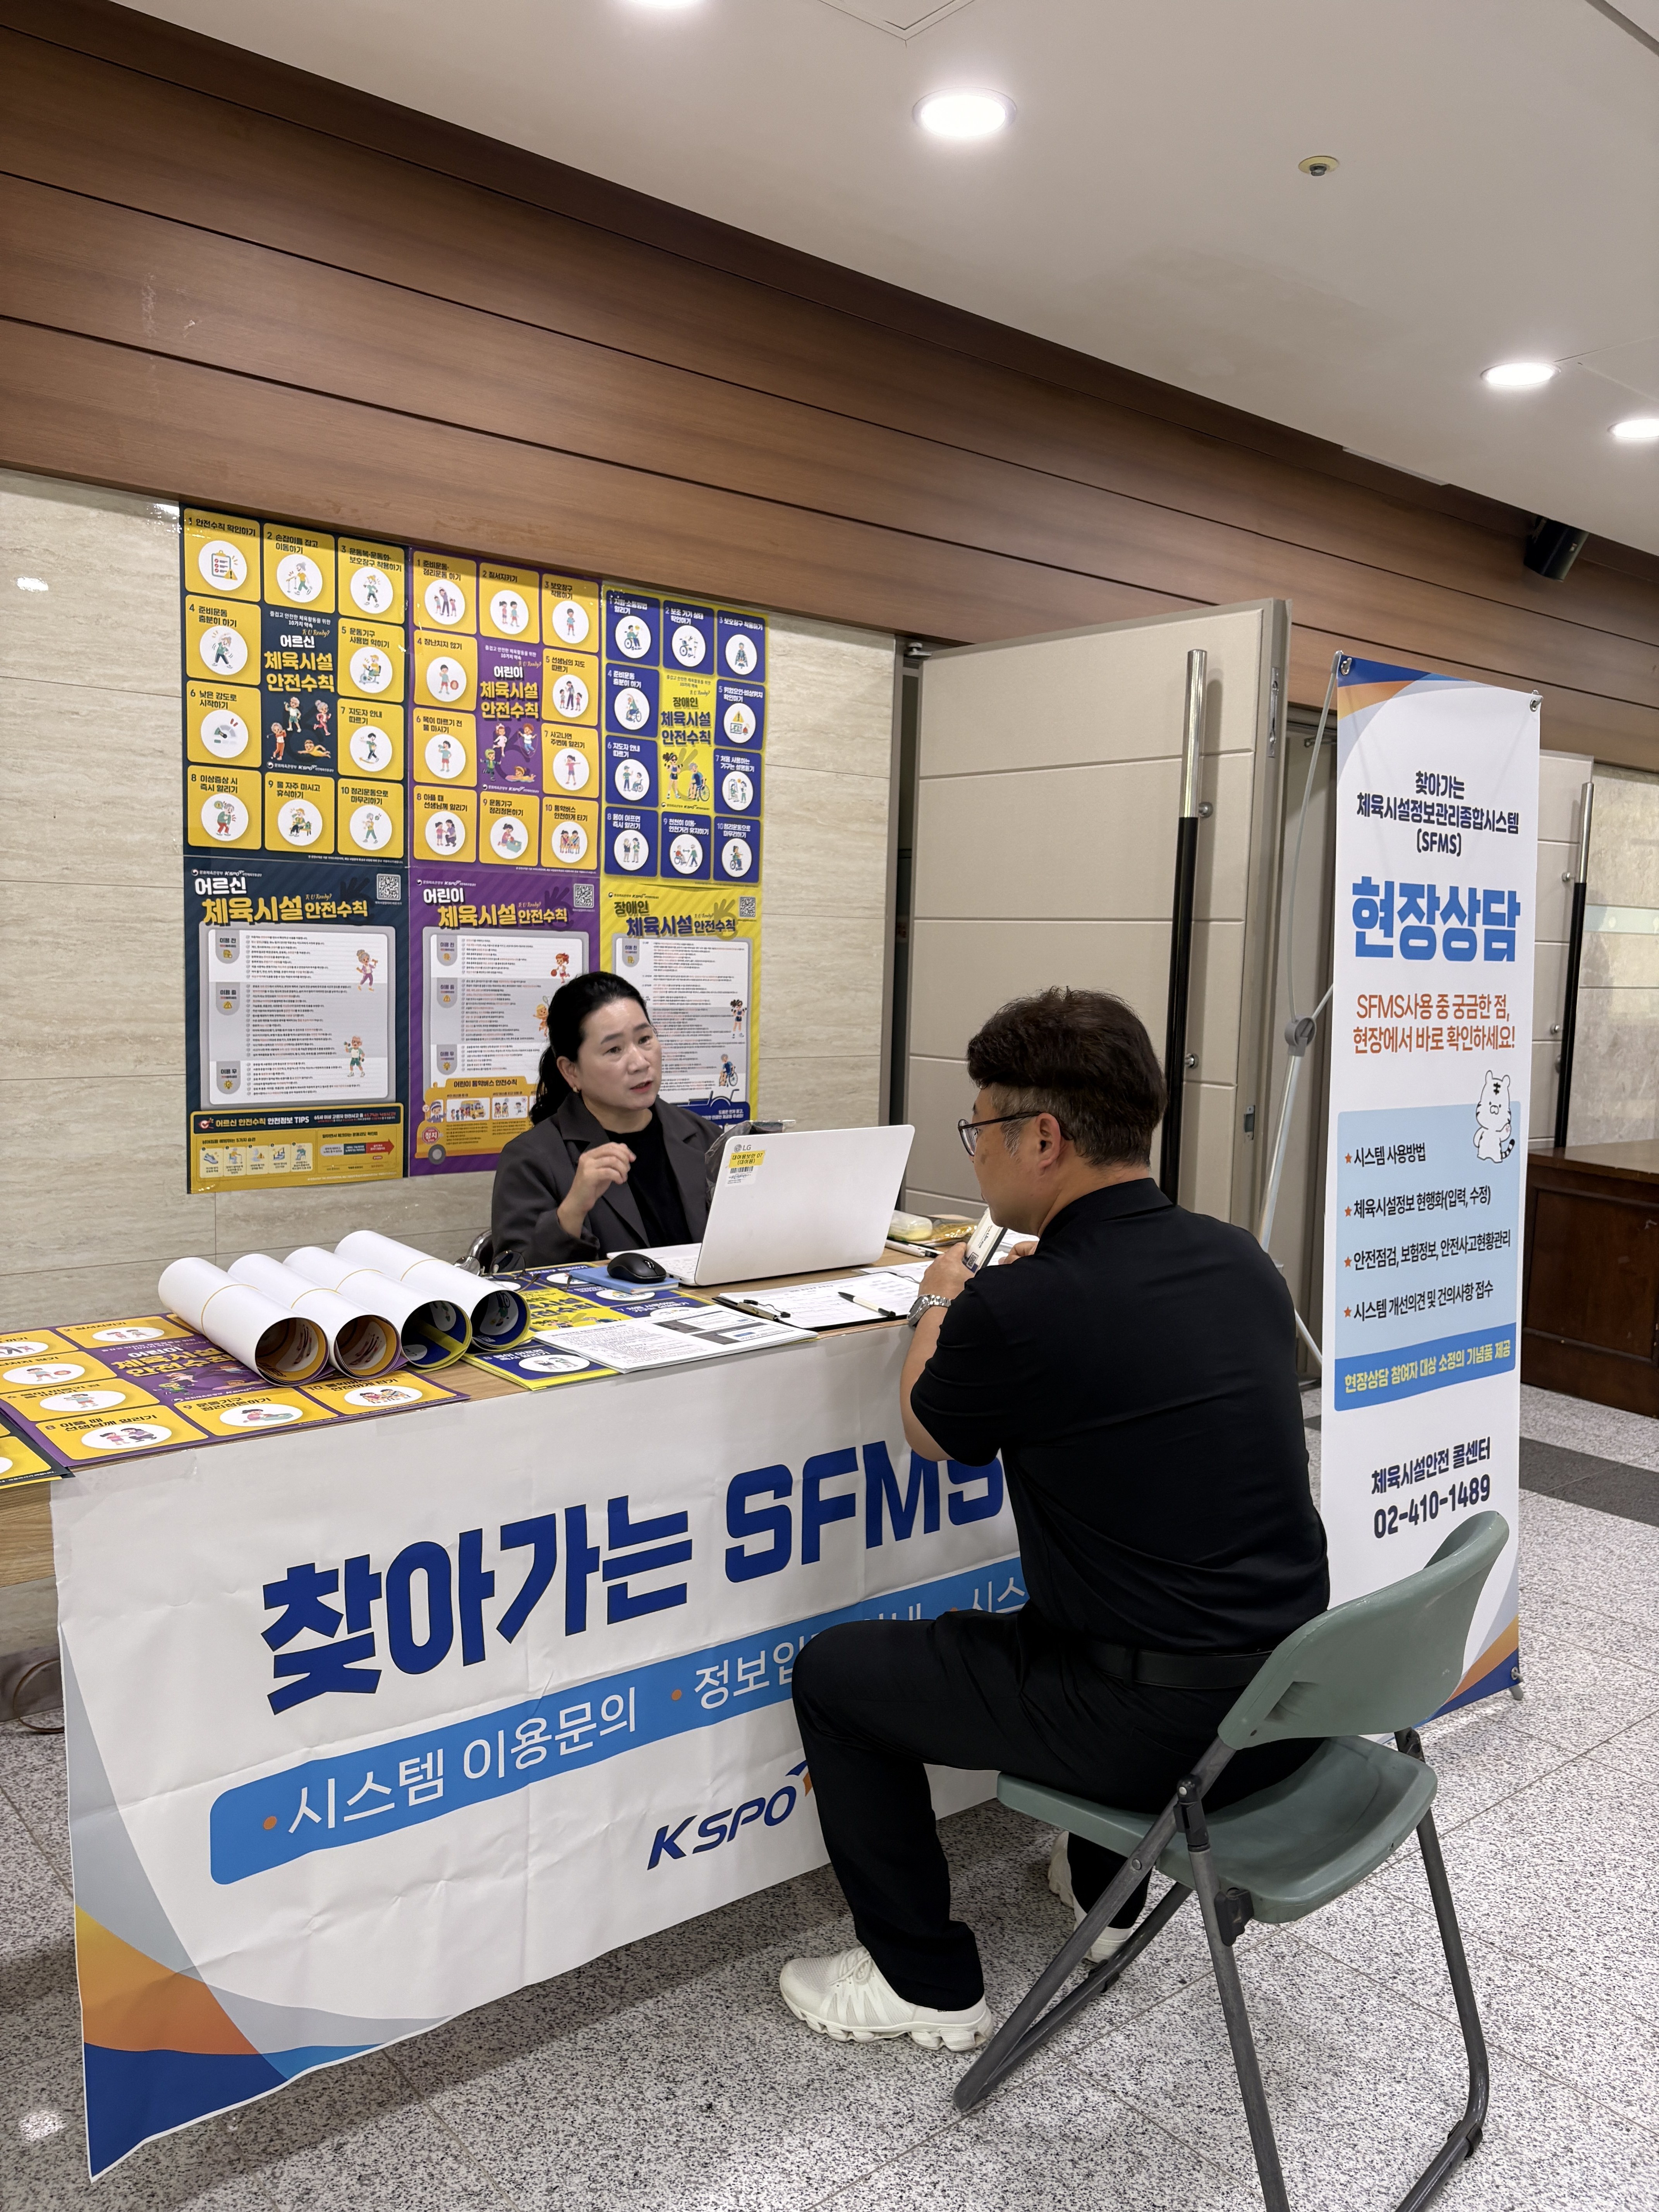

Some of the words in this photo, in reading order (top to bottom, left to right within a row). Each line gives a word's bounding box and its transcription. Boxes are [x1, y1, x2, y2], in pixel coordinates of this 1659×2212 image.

[196, 518, 225, 531] 안전수칙
[227, 524, 256, 537] 확인하기
[276, 534, 303, 545] 손잡이를
[305, 539, 318, 548] 잡고
[276, 543, 303, 554] 이동하기
[423, 569, 447, 579] 정리운동
[449, 572, 461, 581] 하기
[489, 571, 517, 582] 질서지키기
[551, 582, 572, 591] 보호장구
[551, 591, 572, 599] 착용하기
[189, 604, 195, 612] 4
[199, 605, 227, 617] 준비운동
[199, 615, 220, 625] 충분히
[223, 618, 237, 627] 하기
[350, 627, 375, 637] 운동기구
[280, 635, 315, 648] 어르신
[350, 636, 369, 645] 사용법
[371, 639, 389, 648] 익히기
[424, 638, 448, 648] 장난치지
[450, 641, 462, 650] 않기
[264, 651, 333, 671] 체육시설
[551, 657, 572, 666] 선생님의
[574, 659, 585, 668] 지도
[494, 665, 523, 679] 어린이
[551, 665, 568, 673] 따르기
[266, 673, 335, 693] 안전수칙
[199, 690, 213, 699] 낮은
[216, 692, 237, 702] 강도로
[480, 681, 538, 700] 체육시설
[199, 699, 228, 709] 시작하기
[673, 697, 698, 708] 장애인
[349, 708, 367, 717] 지도자
[370, 710, 382, 718] 안내
[481, 701, 538, 719] 안전수칙
[349, 716, 368, 725] 따르기
[423, 716, 435, 725] 목이
[437, 718, 455, 726] 마르기
[661, 711, 711, 727] 체육시설
[431, 725, 449, 734] 마시기
[551, 732, 572, 740] 사고나면
[662, 729, 711, 745] 안전수칙
[551, 739, 567, 747] 주변에
[569, 740, 585, 749] 알리기
[201, 774, 228, 785] 이상증상
[1415, 770, 1465, 800] 찾아가는
[201, 783, 215, 792] 즉시
[217, 784, 237, 793] 알리기
[285, 781, 298, 790] 자주
[301, 783, 320, 792] 마시고
[351, 788, 388, 797] 정리운동으로
[277, 789, 303, 799] 휴식하기
[351, 795, 382, 805] 마무리하기
[424, 802, 448, 811] 선생님께
[489, 799, 512, 808] 운동기구
[554, 805, 575, 813] 통학버스
[489, 807, 523, 816] 정리정돈하기
[1357, 792, 1519, 835] 체육시설정보관리종합시스템
[625, 814, 641, 823] 아프면
[1417, 828, 1461, 857] (SFMS)
[195, 877, 247, 895] 어르신
[423, 888, 464, 904] 어린이
[201, 895, 303, 924] 체육시설
[305, 900, 368, 919] 안전수칙
[614, 901, 649, 915] 장애인
[437, 903, 517, 927] 체육시설
[518, 908, 568, 924] 안전수칙
[1352, 876, 1520, 962] 현장상담
[626, 915, 692, 936] 체육시설
[694, 919, 736, 933] 안전수칙
[1357, 994, 1433, 1020] SFMS사용
[1436, 994, 1449, 1019] 중
[1453, 994, 1491, 1019] 궁금한
[1494, 994, 1510, 1022] 점,
[1353, 1026, 1412, 1054] 현장에서
[1416, 1026, 1444, 1051] 바로
[1447, 1025, 1515, 1051] 확인하세요!
[216, 1118, 237, 1128] 어르신
[239, 1117, 266, 1127] 안전수칙
[268, 1116, 292, 1126] 안전정보
[1354, 1146, 1385, 1167] 시스템
[1387, 1143, 1426, 1164] 사용방법
[1353, 1192, 1414, 1219] 체육시설정보
[1417, 1188, 1468, 1211] 현행화(입력,
[1470, 1185, 1491, 1205] 수정)
[1354, 1246, 1399, 1271] 안전점검,
[1401, 1241, 1439, 1262] 보험정보,
[1441, 1229, 1511, 1257] 안전사고현황관리
[1353, 1299, 1386, 1321] 시스템
[1389, 1291, 1425, 1316] 개선의견
[1427, 1289, 1436, 1308] 및
[1437, 1282, 1474, 1307] 건의사항
[1475, 1280, 1494, 1300] 접수
[1345, 1367, 1389, 1393] 현장상담
[1391, 1360, 1417, 1385] 참여자
[1420, 1356, 1436, 1377] 대상
[1439, 1350, 1464, 1372] 소정의
[1467, 1344, 1492, 1365] 기념품
[1494, 1340, 1510, 1359] 제공
[120, 1415, 157, 1423] 알리기
[1371, 1448, 1449, 1494] 체육시설안전
[1453, 1436, 1490, 1469] 콜센터
[1374, 1474, 1490, 1539] 02-410-1489
[261, 1495, 693, 1716] 찾아가는
[725, 1440, 1003, 1583] SFMS
[288, 1748, 443, 1834] 시스템
[464, 1687, 636, 1779] 이용문의
[694, 1632, 819, 1709] 정보입
[647, 1786, 796, 1870] KSPO
